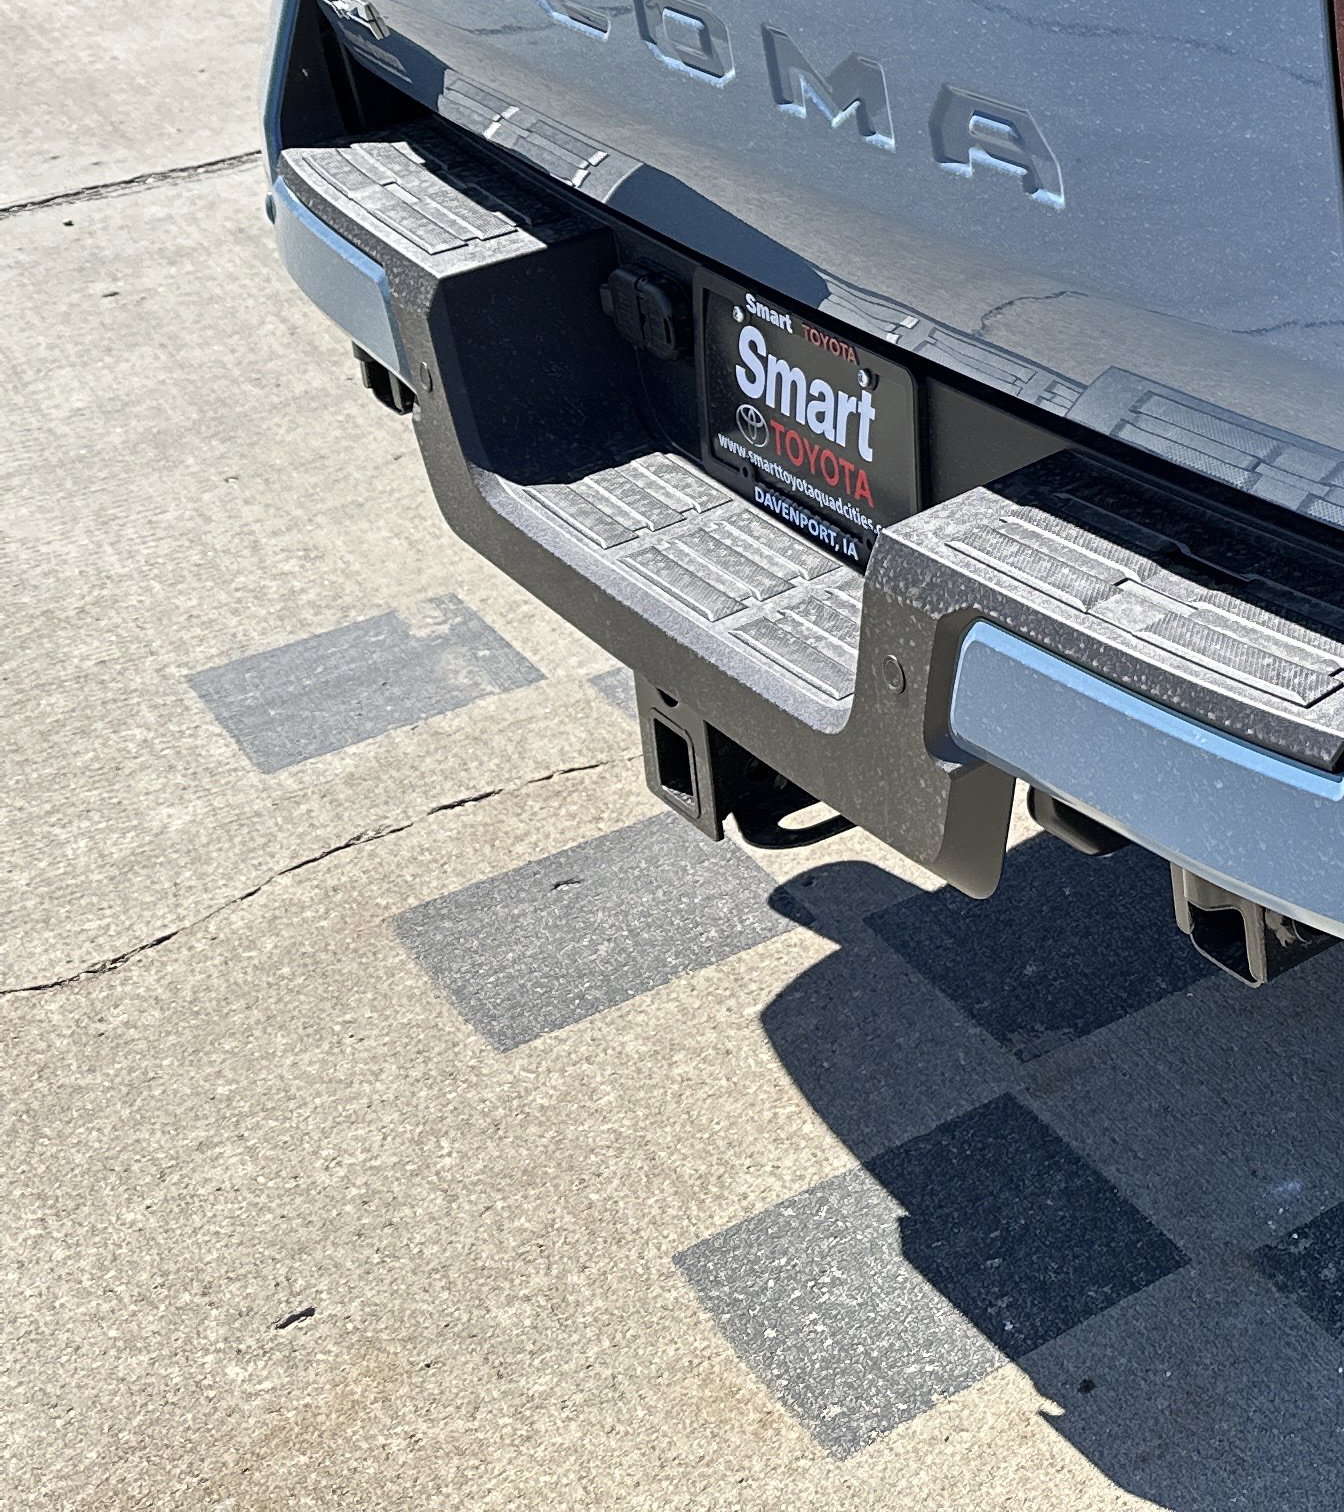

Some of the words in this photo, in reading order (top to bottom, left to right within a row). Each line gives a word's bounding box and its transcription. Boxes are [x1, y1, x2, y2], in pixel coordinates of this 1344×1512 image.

[745, 293, 793, 334] Smart
[801, 322, 862, 366] TOYOTA
[735, 325, 876, 462] Smart
[769, 418, 875, 508] TOYOTA
[754, 485, 840, 551] DAVENPORT,
[842, 533, 859, 561] IA
